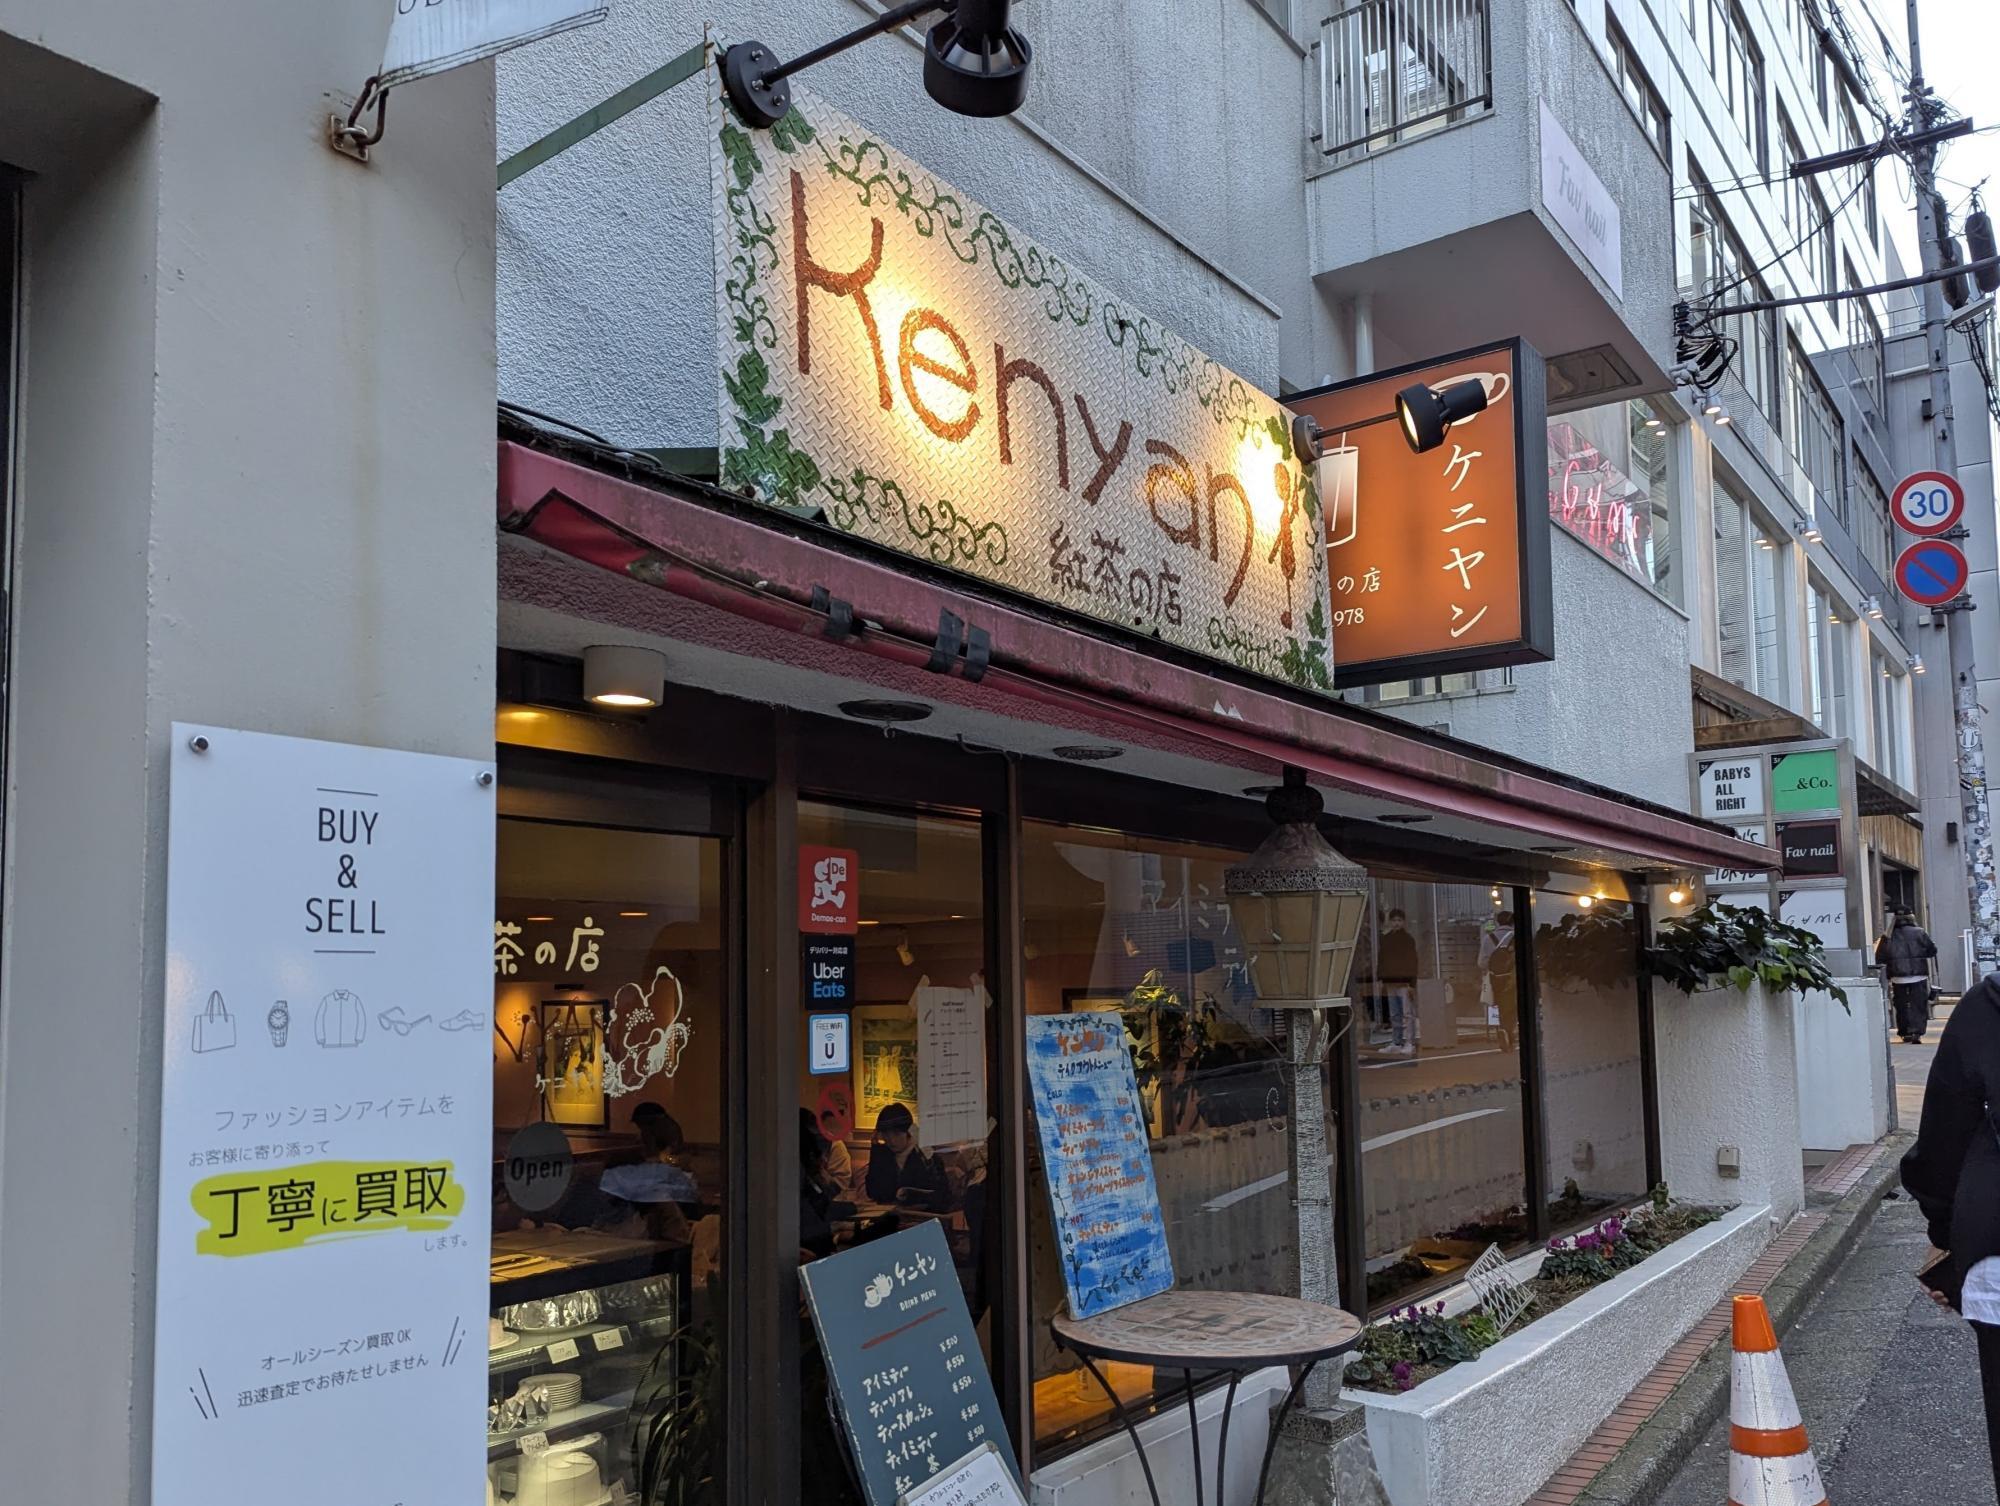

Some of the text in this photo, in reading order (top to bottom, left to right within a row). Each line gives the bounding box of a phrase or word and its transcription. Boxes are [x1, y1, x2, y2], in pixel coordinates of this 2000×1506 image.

[1908, 488, 1949, 519] 30
[1048, 523, 1182, 627] 紅茶の店
[1329, 566, 1381, 595] の店
[1331, 607, 1365, 627] 978
[1714, 766, 1751, 781] BABYS
[1715, 783, 1735, 796] ALL
[1716, 797, 1746, 811] RIGHT
[317, 807, 379, 845] BUY
[1786, 844, 1835, 858] Fav nail
[337, 854, 358, 889] &
[305, 898, 386, 934] SELL
[813, 962, 846, 979] Uber
[813, 981, 846, 998] Eats
[214, 1094, 456, 1133] ファッションアイテムを
[188, 1139, 331, 1168] お客様に寄り添って
[510, 1156, 564, 1187] Open
[209, 1166, 449, 1239] 丁寧に買取
[424, 1233, 468, 1252] します。
[261, 1328, 413, 1371] オールシーズン買取 OK
[236, 1353, 429, 1409] 迅速査定でお待たせしません
